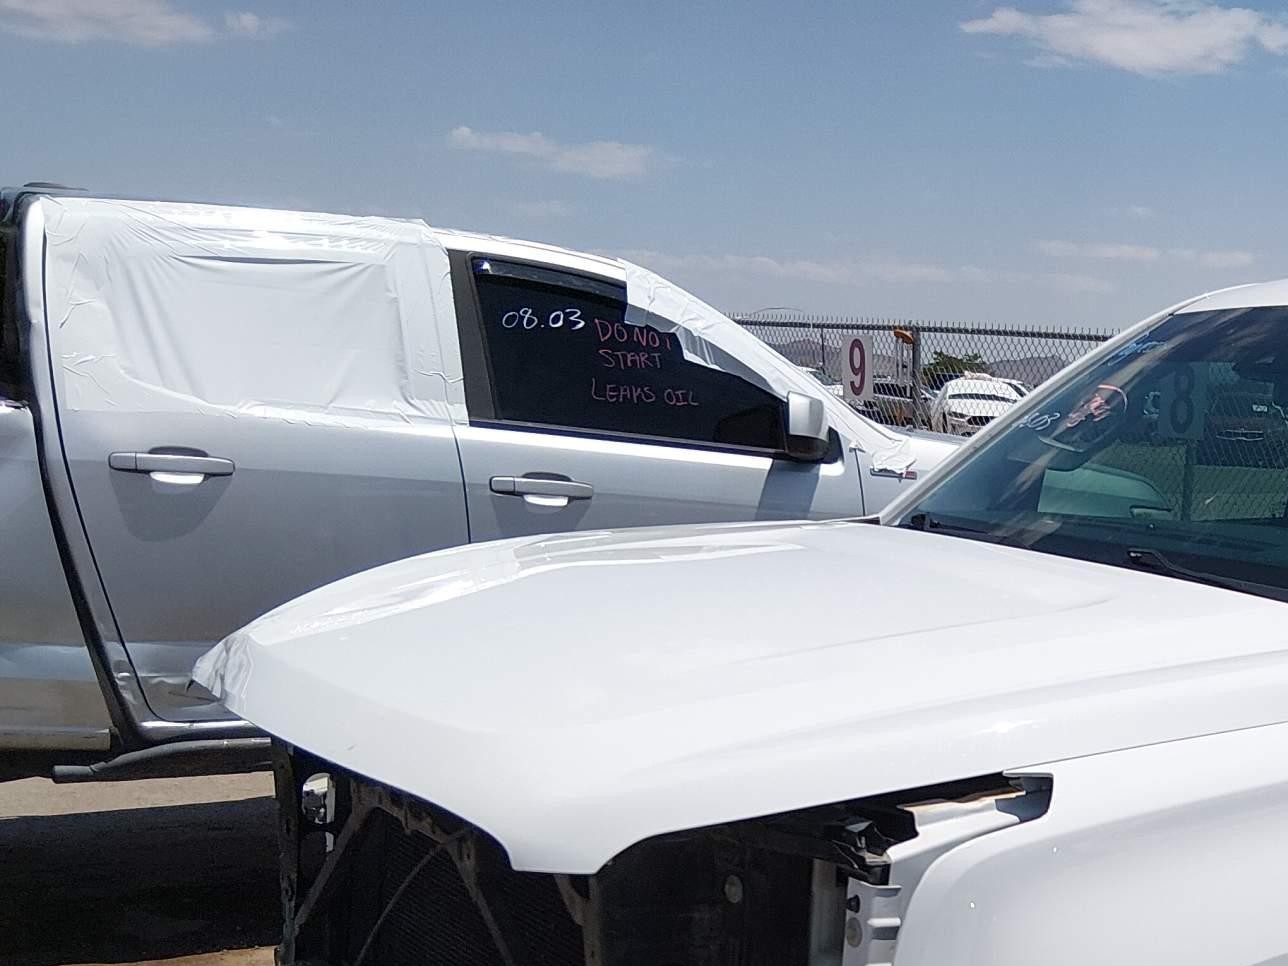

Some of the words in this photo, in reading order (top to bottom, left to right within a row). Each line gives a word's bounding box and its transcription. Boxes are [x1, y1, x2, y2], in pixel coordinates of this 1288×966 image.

[502, 307, 586, 330] 08.03
[598, 349, 662, 370] START
[849, 338, 866, 396] 9
[591, 377, 657, 405] LEAKS
[663, 388, 699, 406] OIL
[1170, 365, 1194, 433] 8
